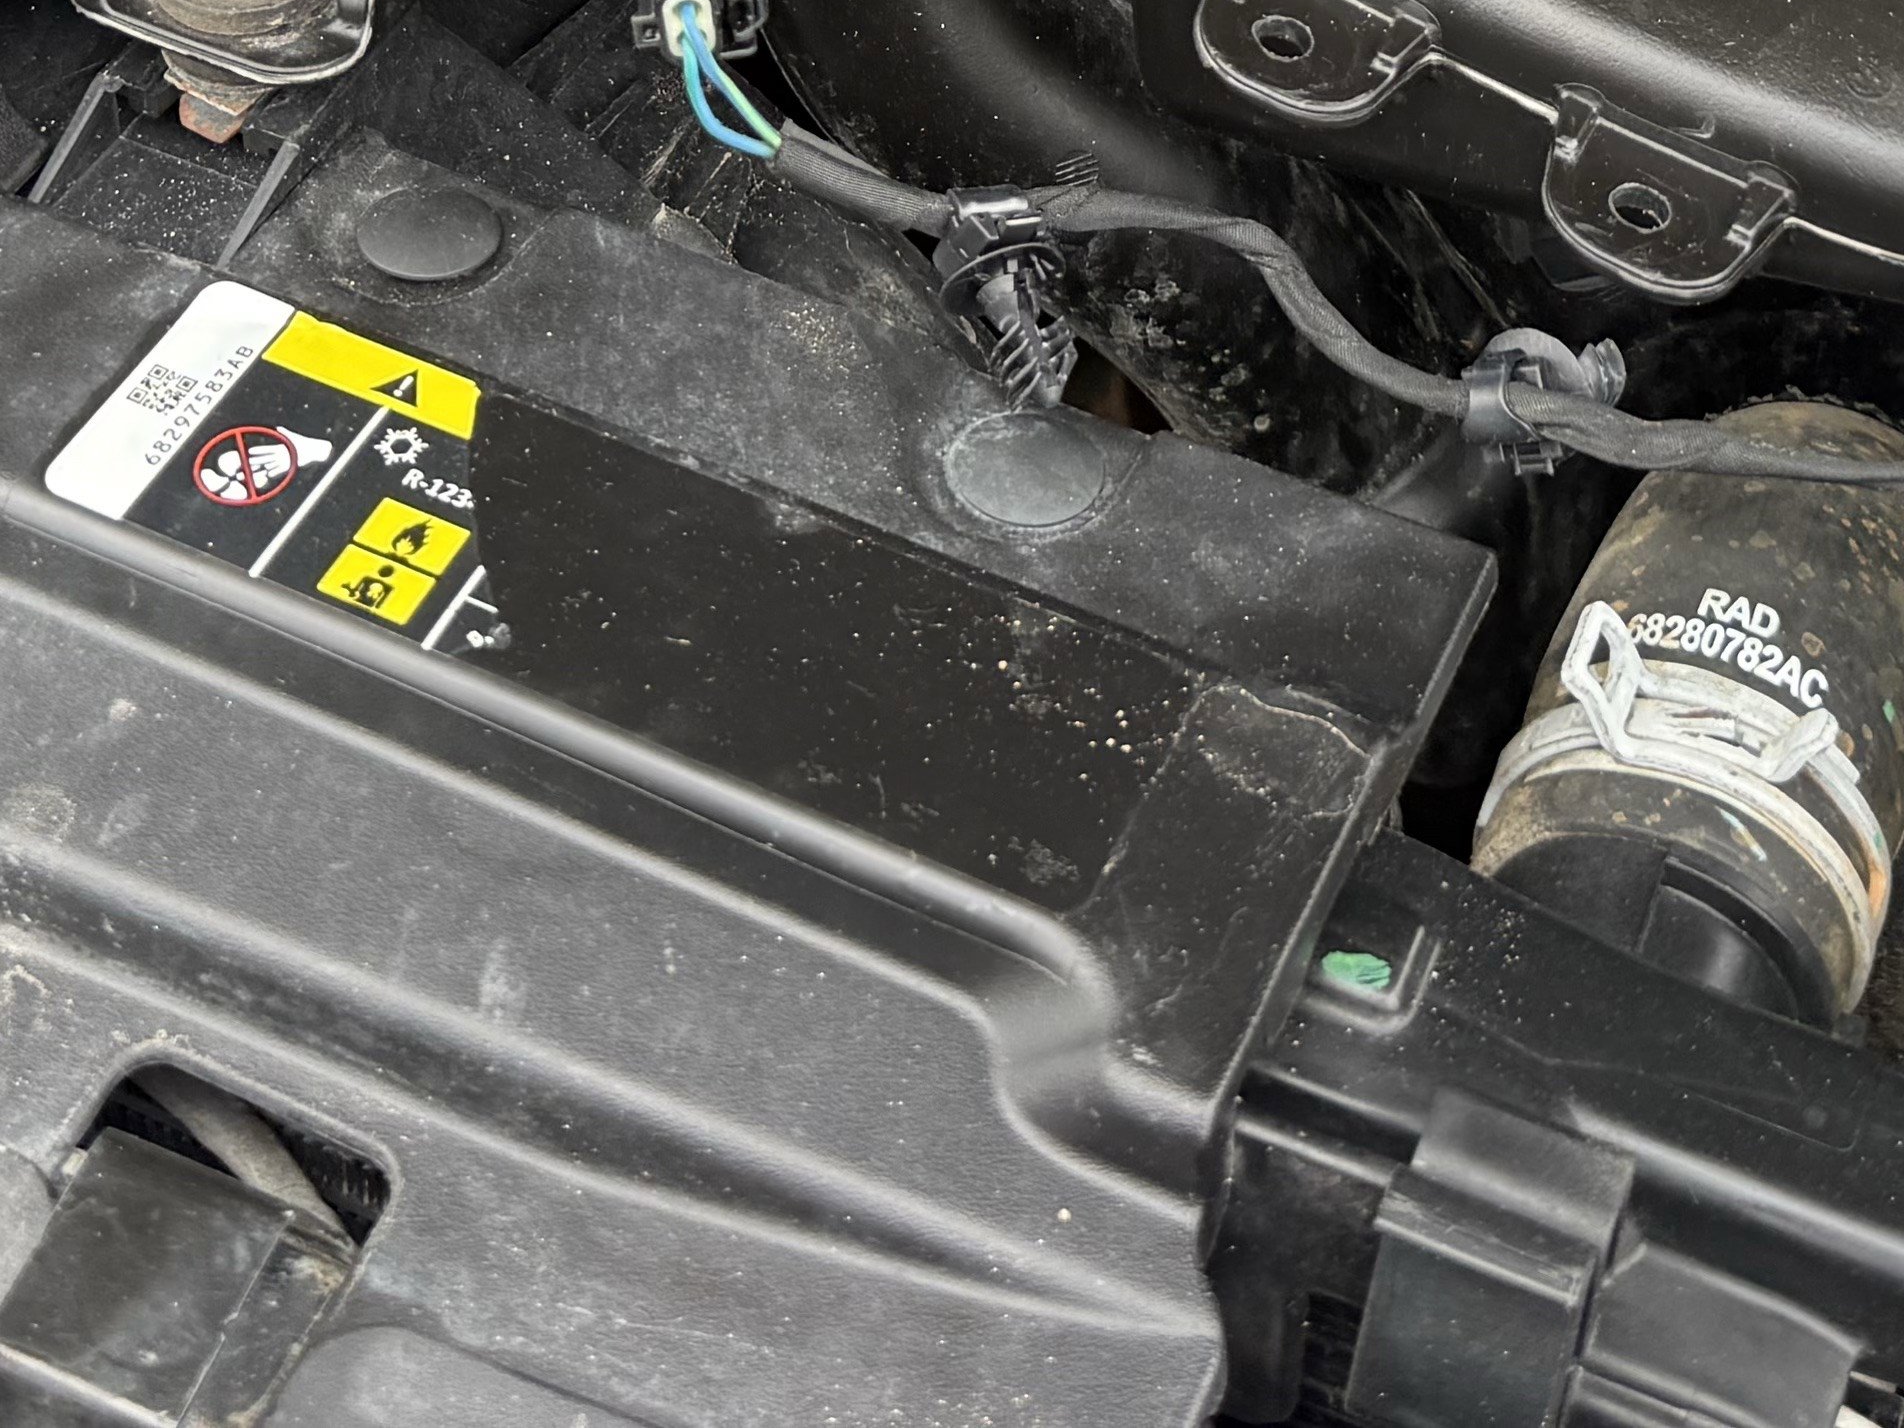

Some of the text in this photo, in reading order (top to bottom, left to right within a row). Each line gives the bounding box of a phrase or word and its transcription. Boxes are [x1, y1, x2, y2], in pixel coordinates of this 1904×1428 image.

[144, 345, 254, 466] 68297583AB
[401, 467, 475, 510] R-123
[1697, 588, 1781, 639] RAD
[1625, 611, 1830, 709] 68280782AC
